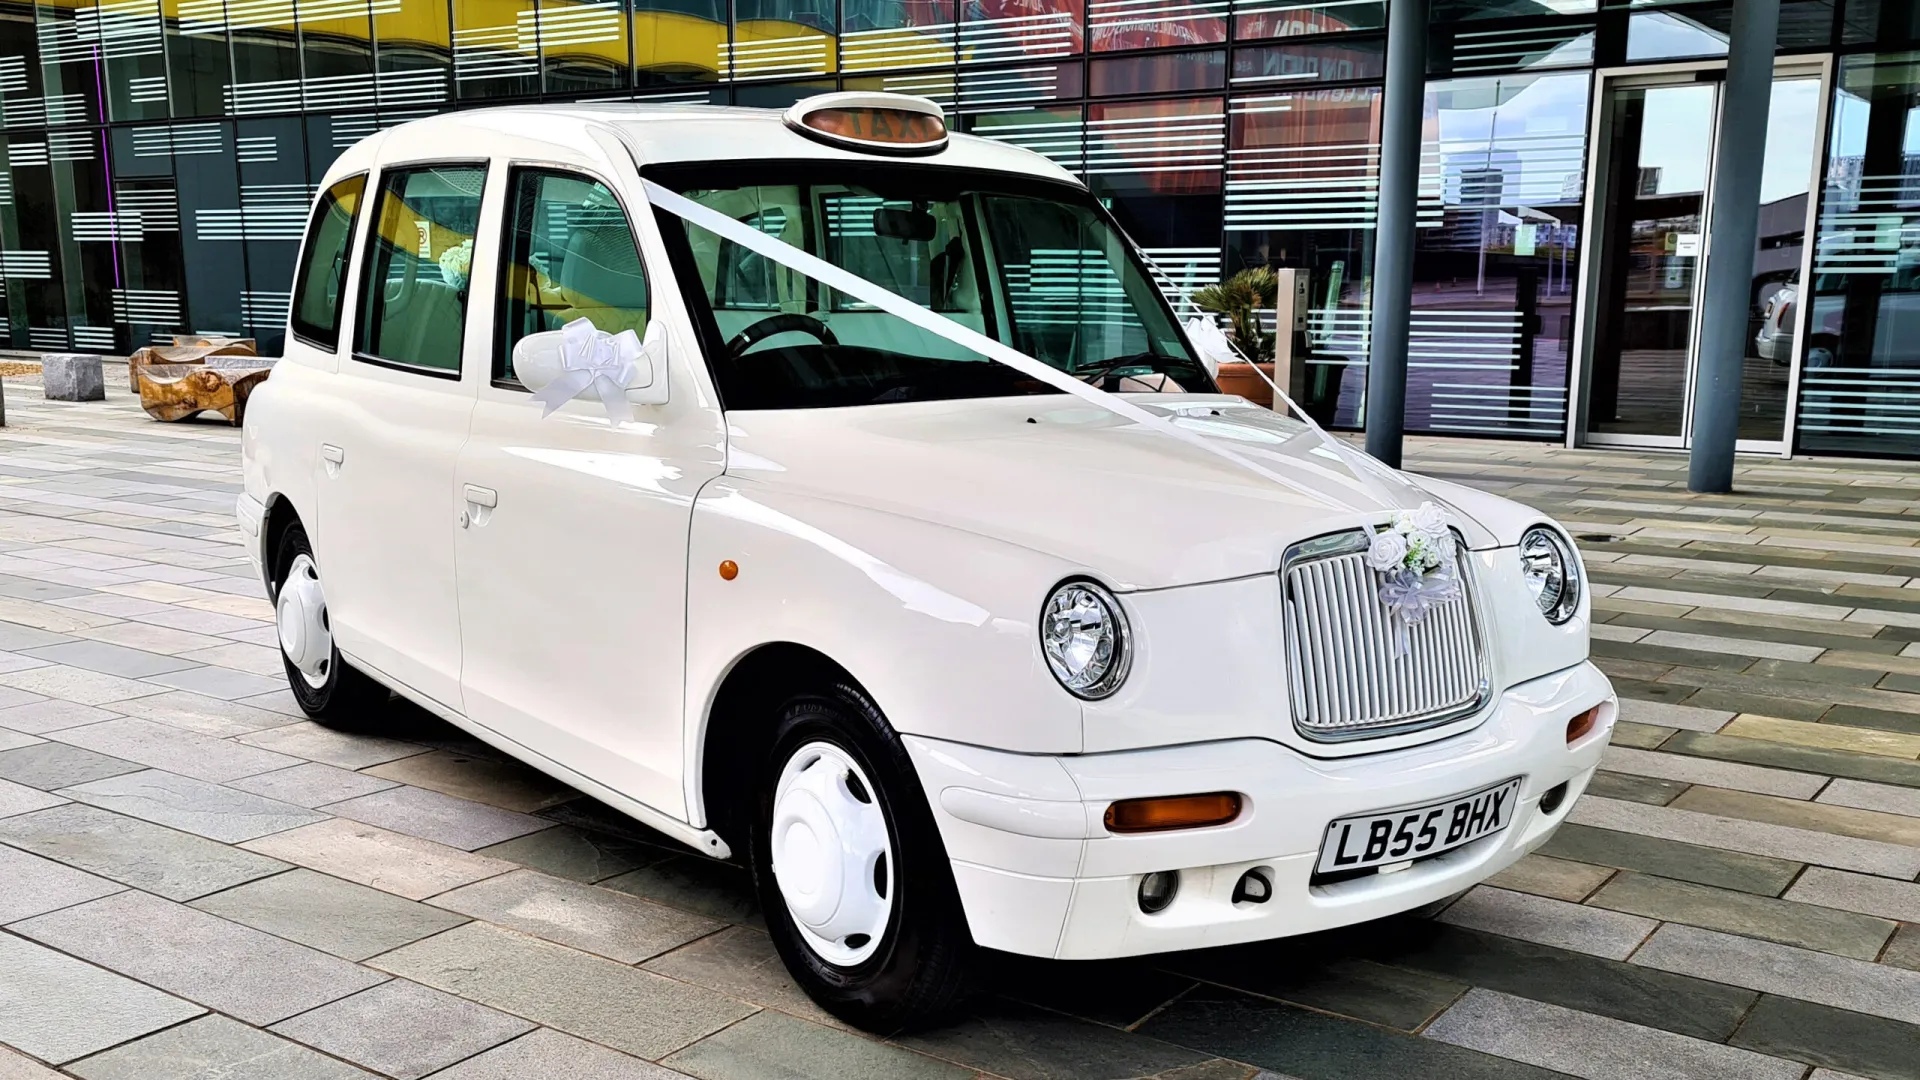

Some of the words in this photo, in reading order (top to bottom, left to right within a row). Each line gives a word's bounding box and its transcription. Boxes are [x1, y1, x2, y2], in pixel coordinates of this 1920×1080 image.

[847, 108, 930, 139] TAXI
[1333, 809, 1444, 866] LB55
[1444, 786, 1510, 846] BHX
